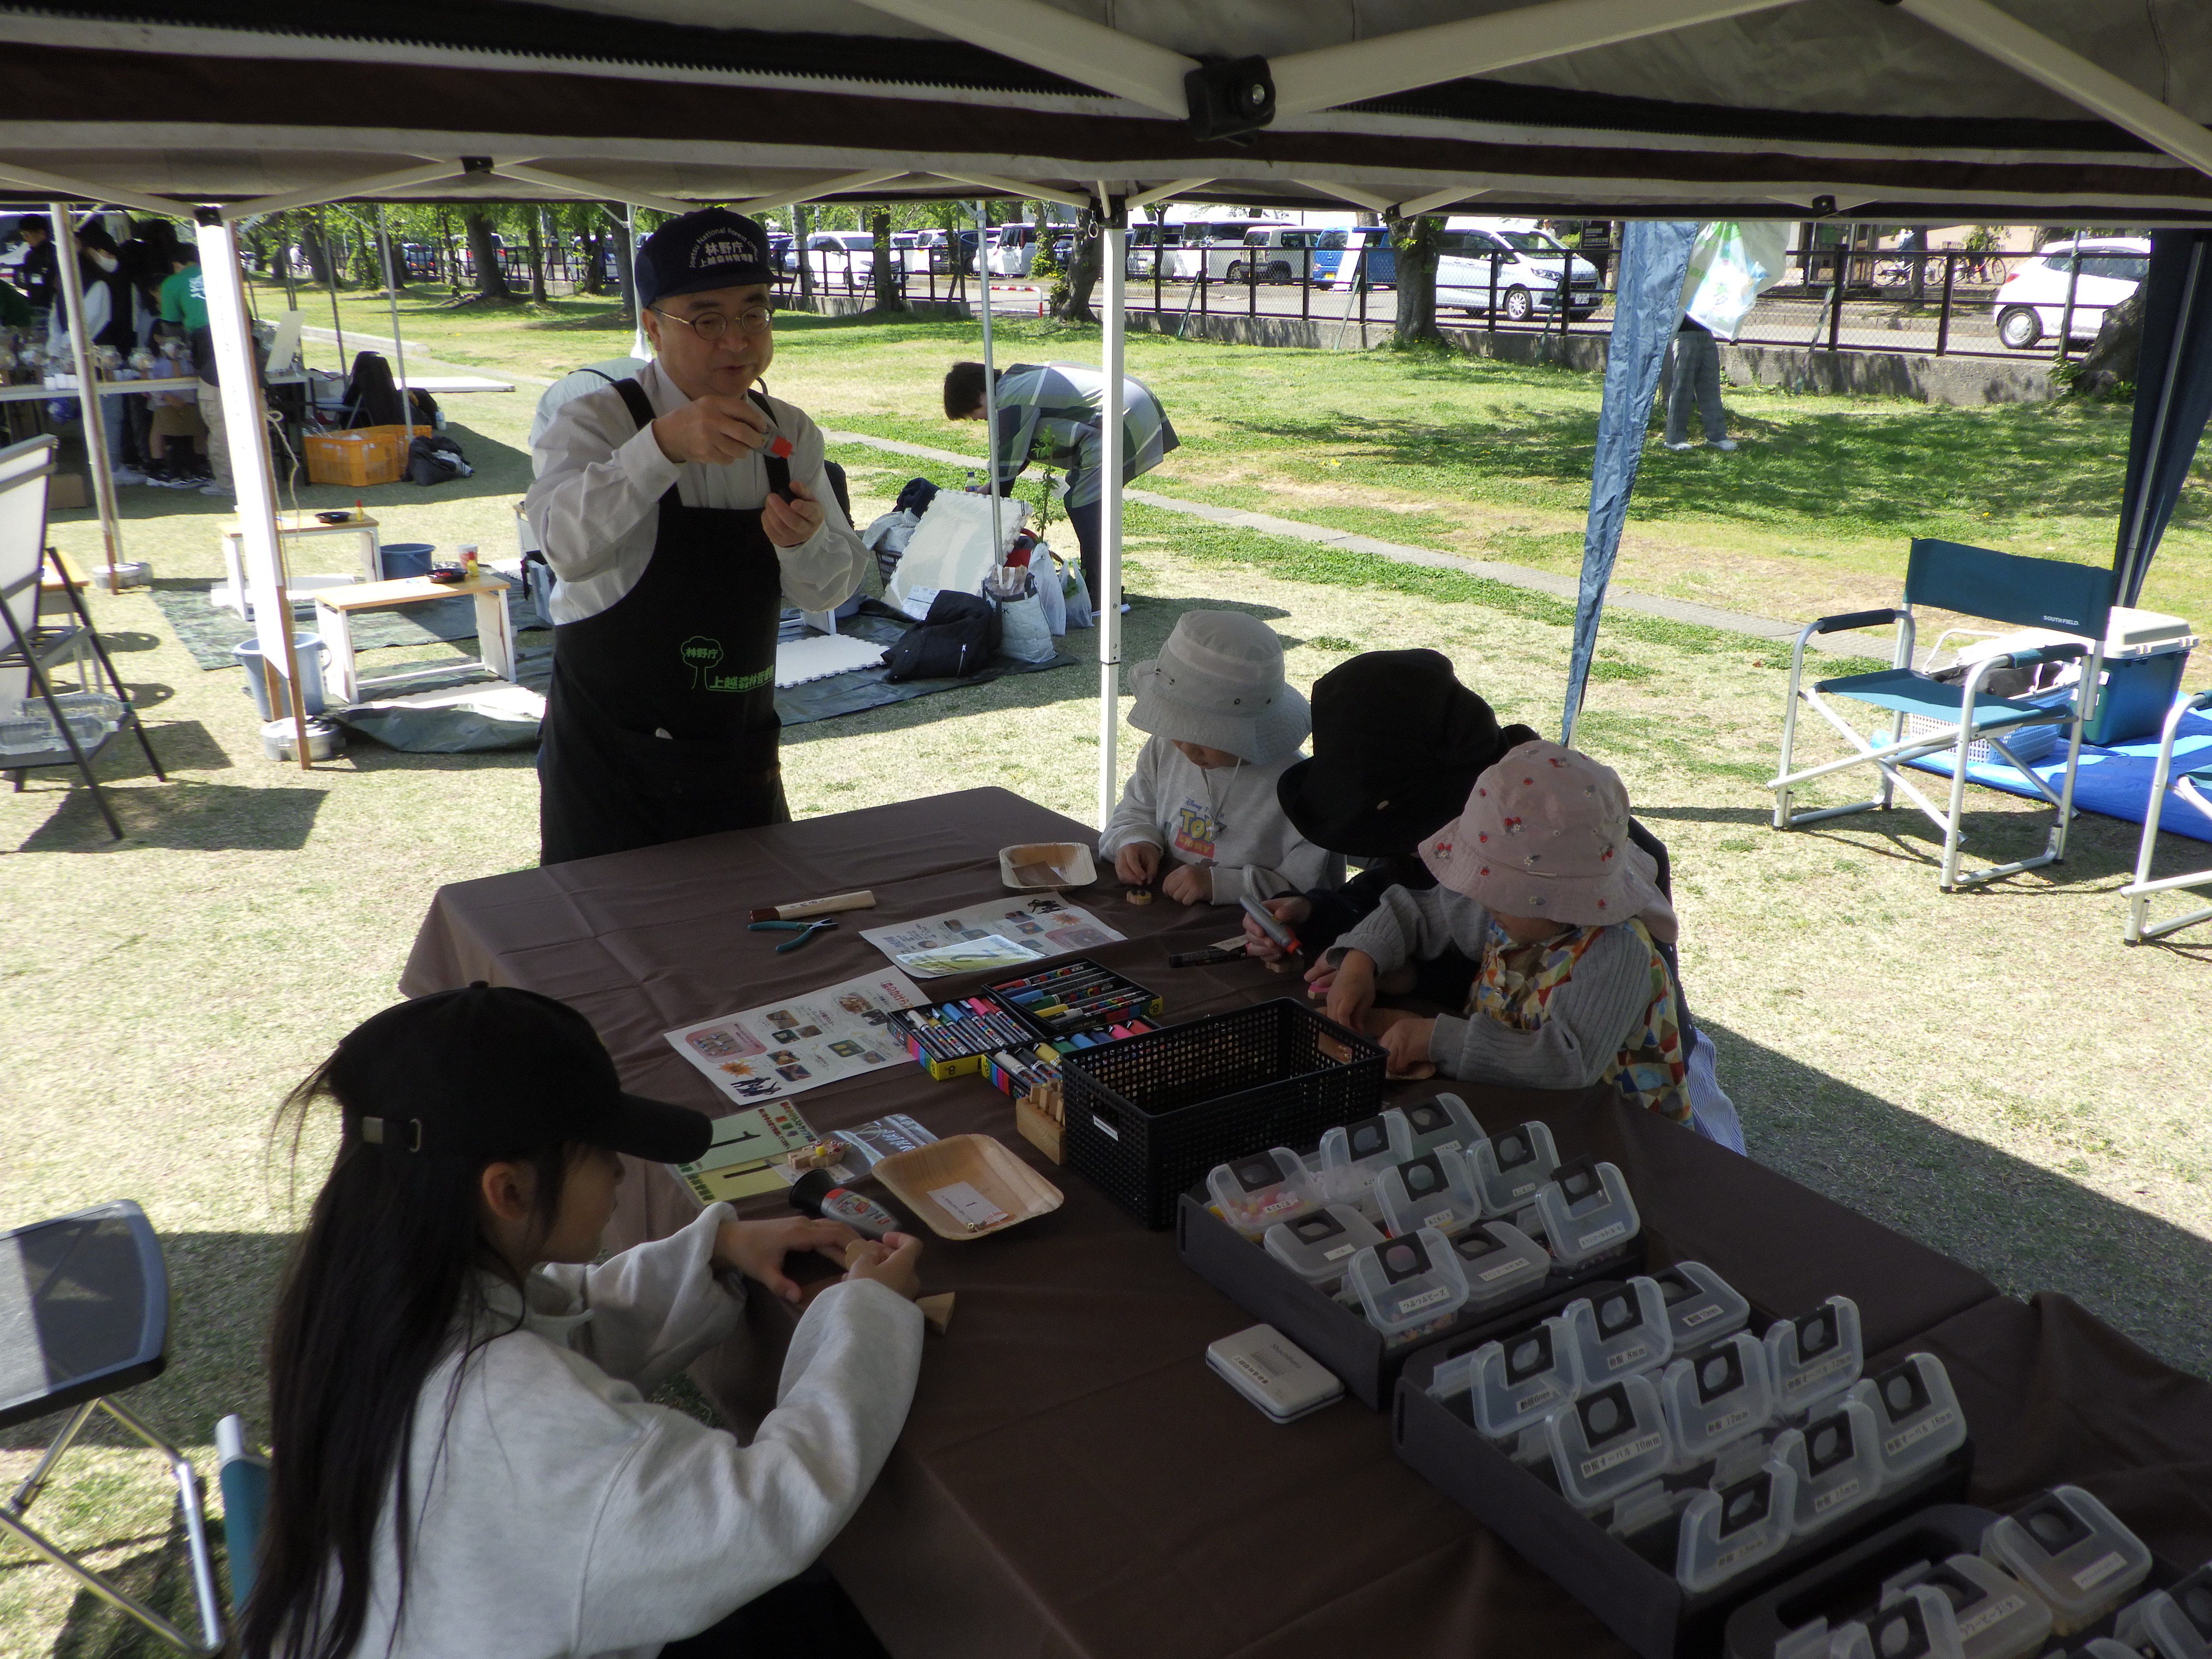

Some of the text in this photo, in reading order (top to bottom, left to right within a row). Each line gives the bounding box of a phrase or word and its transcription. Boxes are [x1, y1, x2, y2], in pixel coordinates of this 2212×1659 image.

[698, 227, 726, 246] National
[704, 241, 744, 256] 林野庁
[685, 647, 719, 659] 林野庁
[1625, 1347, 1646, 1360] 8mm
